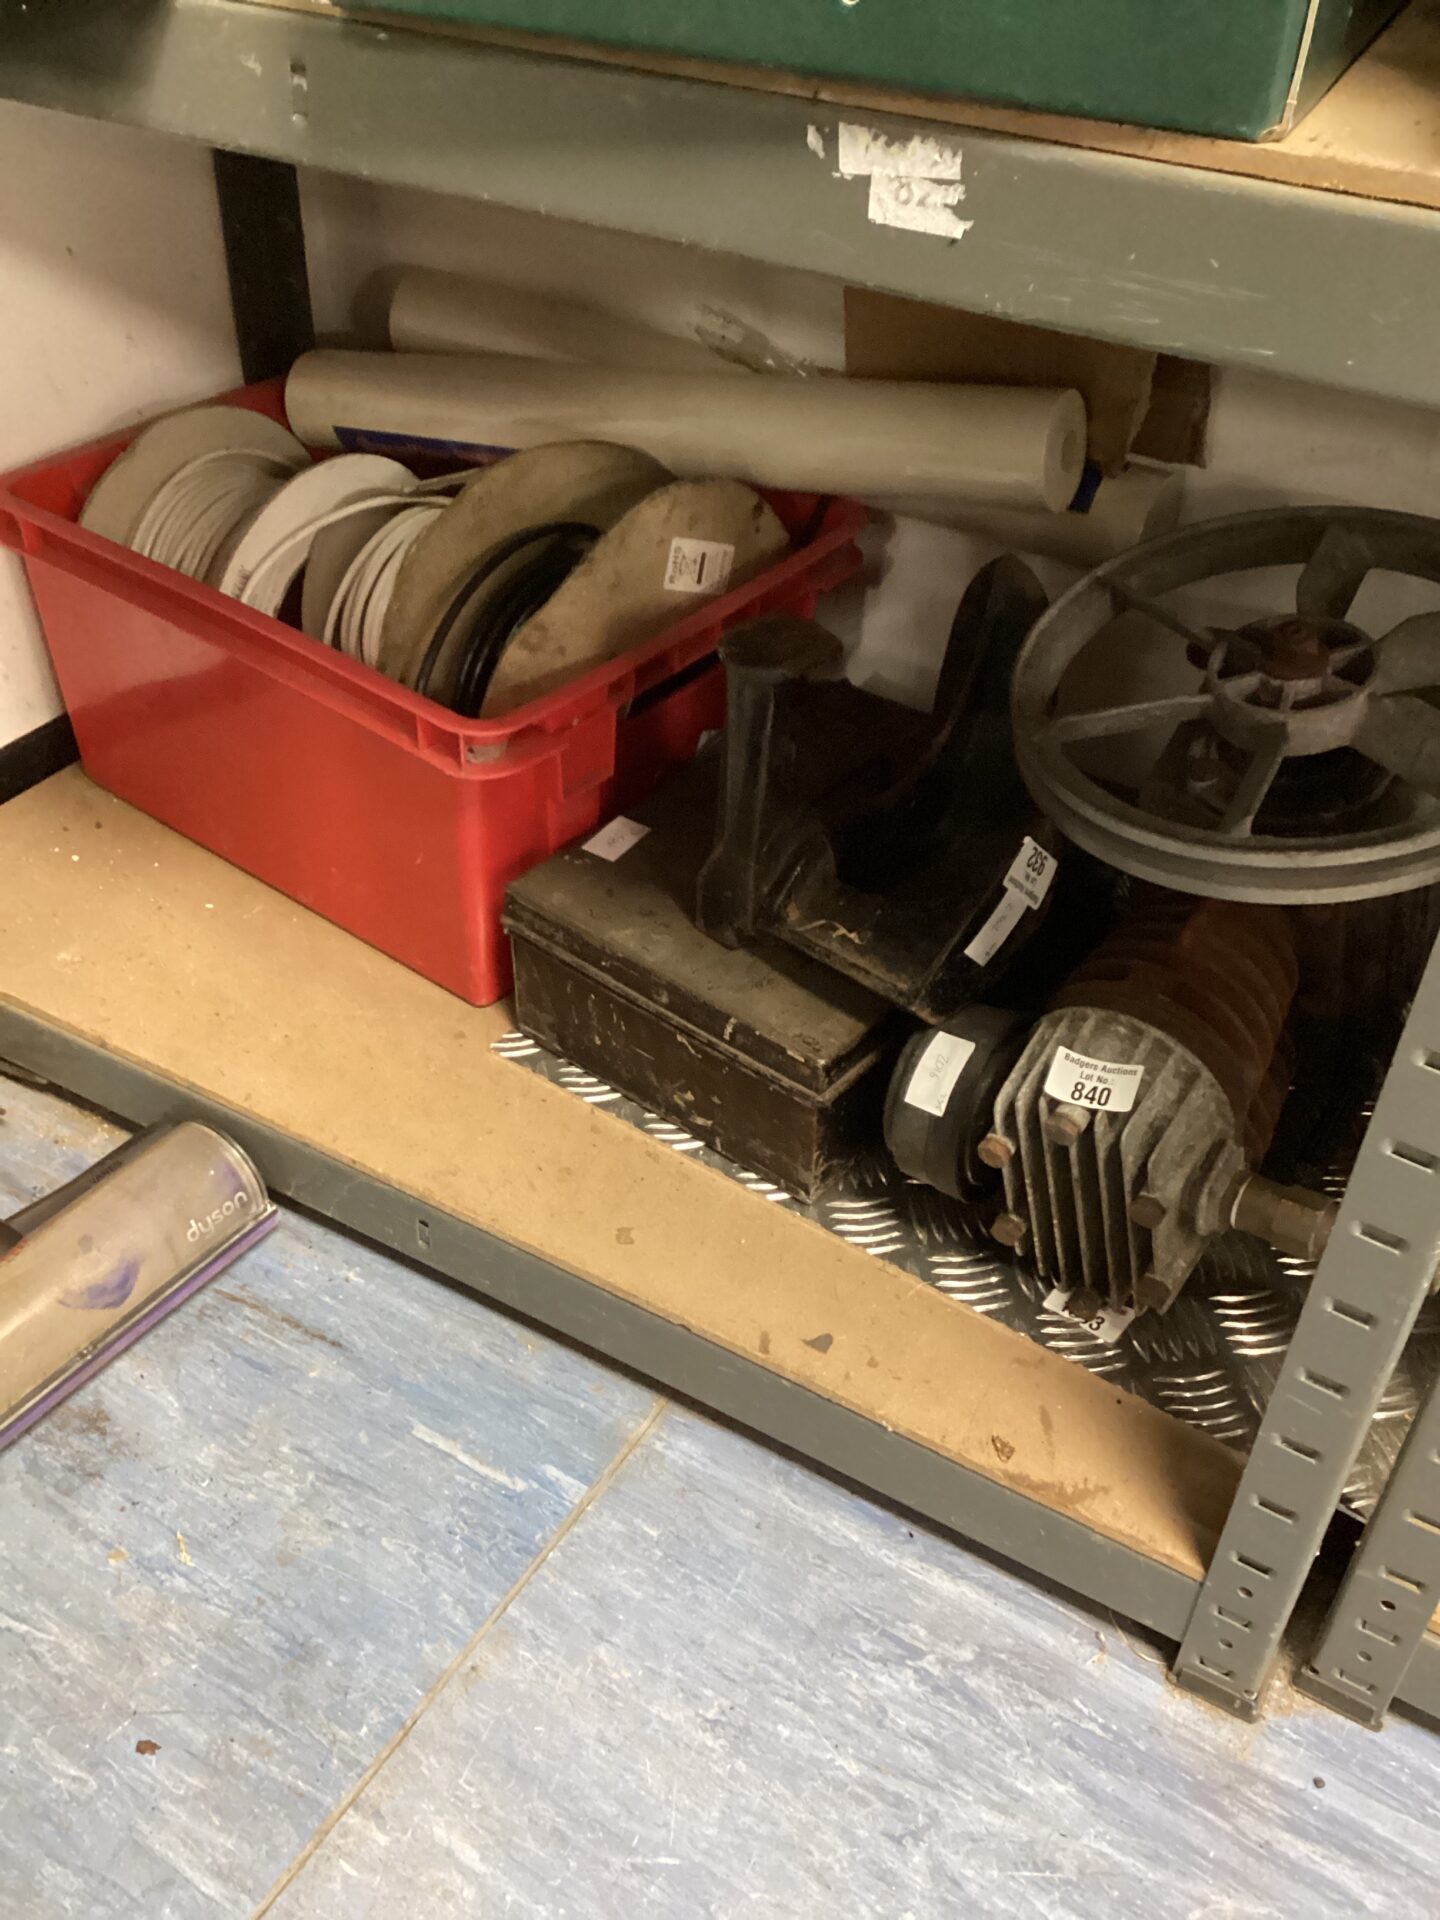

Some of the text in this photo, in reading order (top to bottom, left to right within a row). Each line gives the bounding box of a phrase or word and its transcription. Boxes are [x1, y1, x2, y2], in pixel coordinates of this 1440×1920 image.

[668, 546, 682, 584] RoHS
[1026, 846, 1048, 876] 932
[1064, 1053, 1138, 1076] Badgers Auctions
[1080, 1071, 1094, 1082] Lot
[1071, 1081, 1112, 1106] 840
[185, 1190, 249, 1244] dyson
